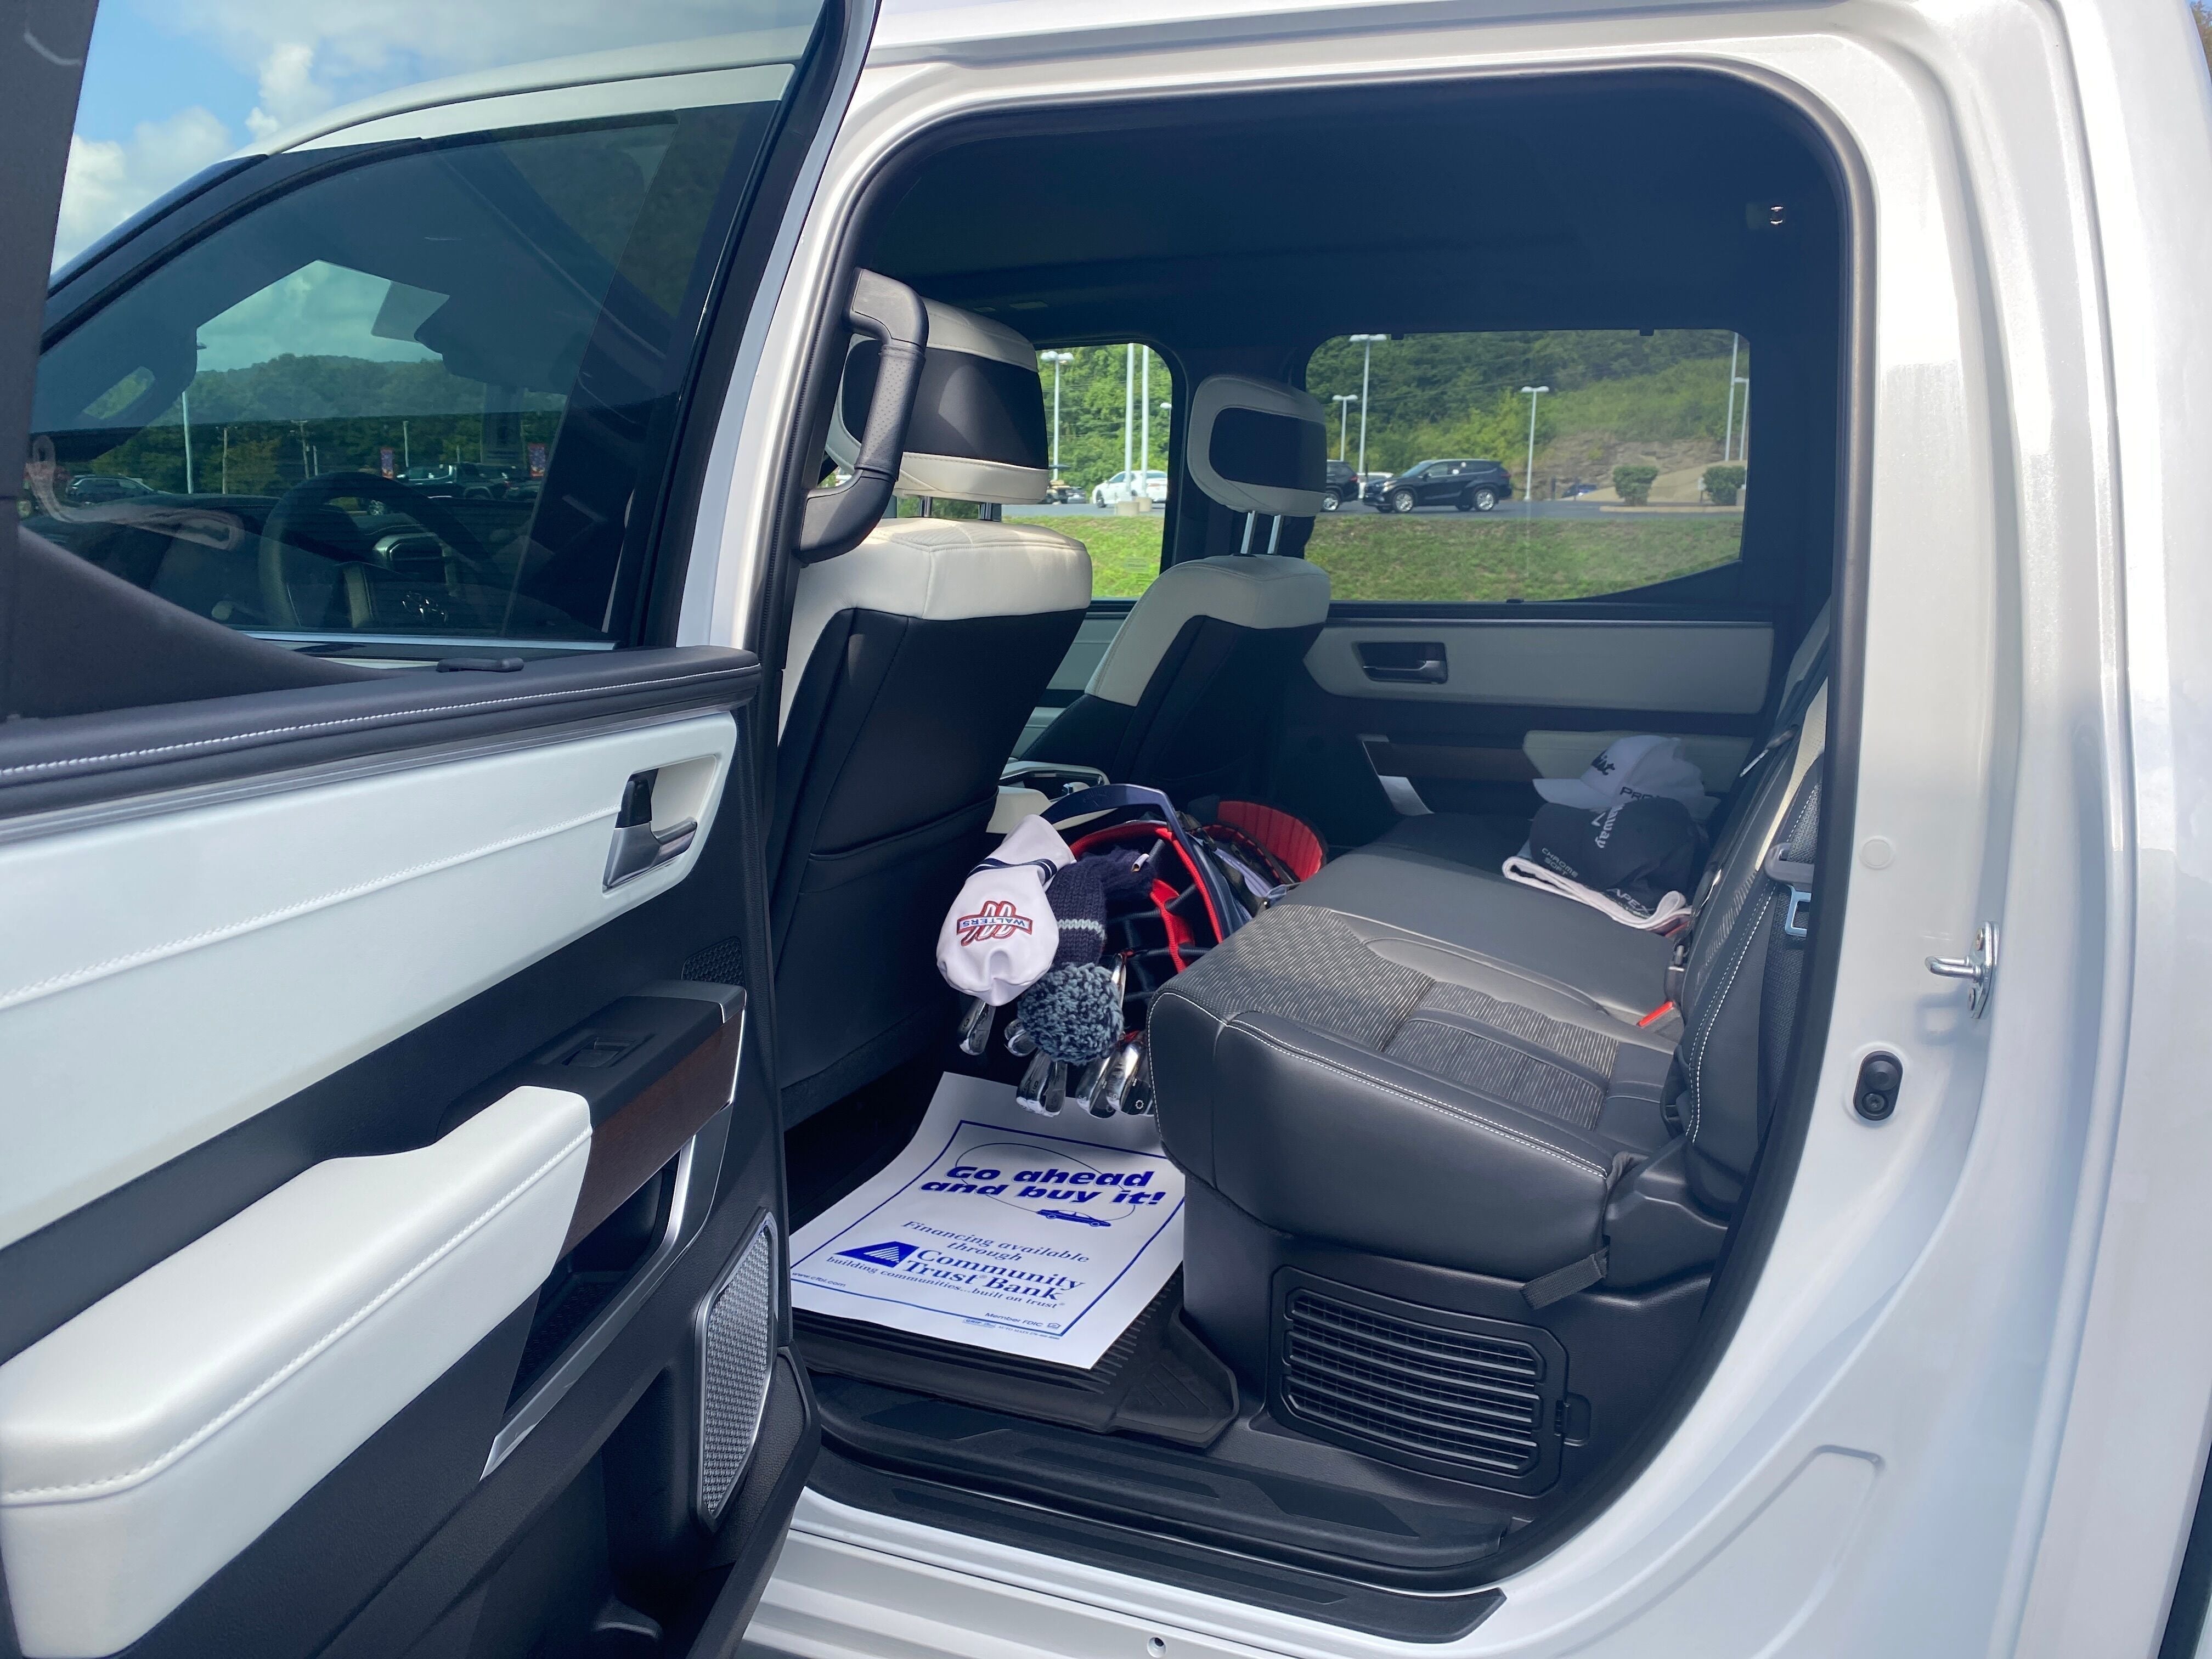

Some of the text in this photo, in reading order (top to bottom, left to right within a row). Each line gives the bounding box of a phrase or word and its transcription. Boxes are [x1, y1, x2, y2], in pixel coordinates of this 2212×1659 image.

[1542, 848, 1578, 877] CHROME
[1544, 857, 1567, 875] SOFT
[1606, 888, 1655, 913] APEX
[963, 918, 1025, 927] WALTERS
[946, 1166, 1154, 1187] Go ahead
[921, 1182, 1166, 1205] and buy it!
[901, 1221, 1089, 1262] Financing available
[947, 1242, 1022, 1261] through
[902, 1260, 1064, 1300] Trust Bank
[917, 1250, 1085, 1290] Community
[826, 1256, 878, 1274] building
[1026, 1299, 1058, 1309] trust
[985, 1312, 1020, 1323] Member
